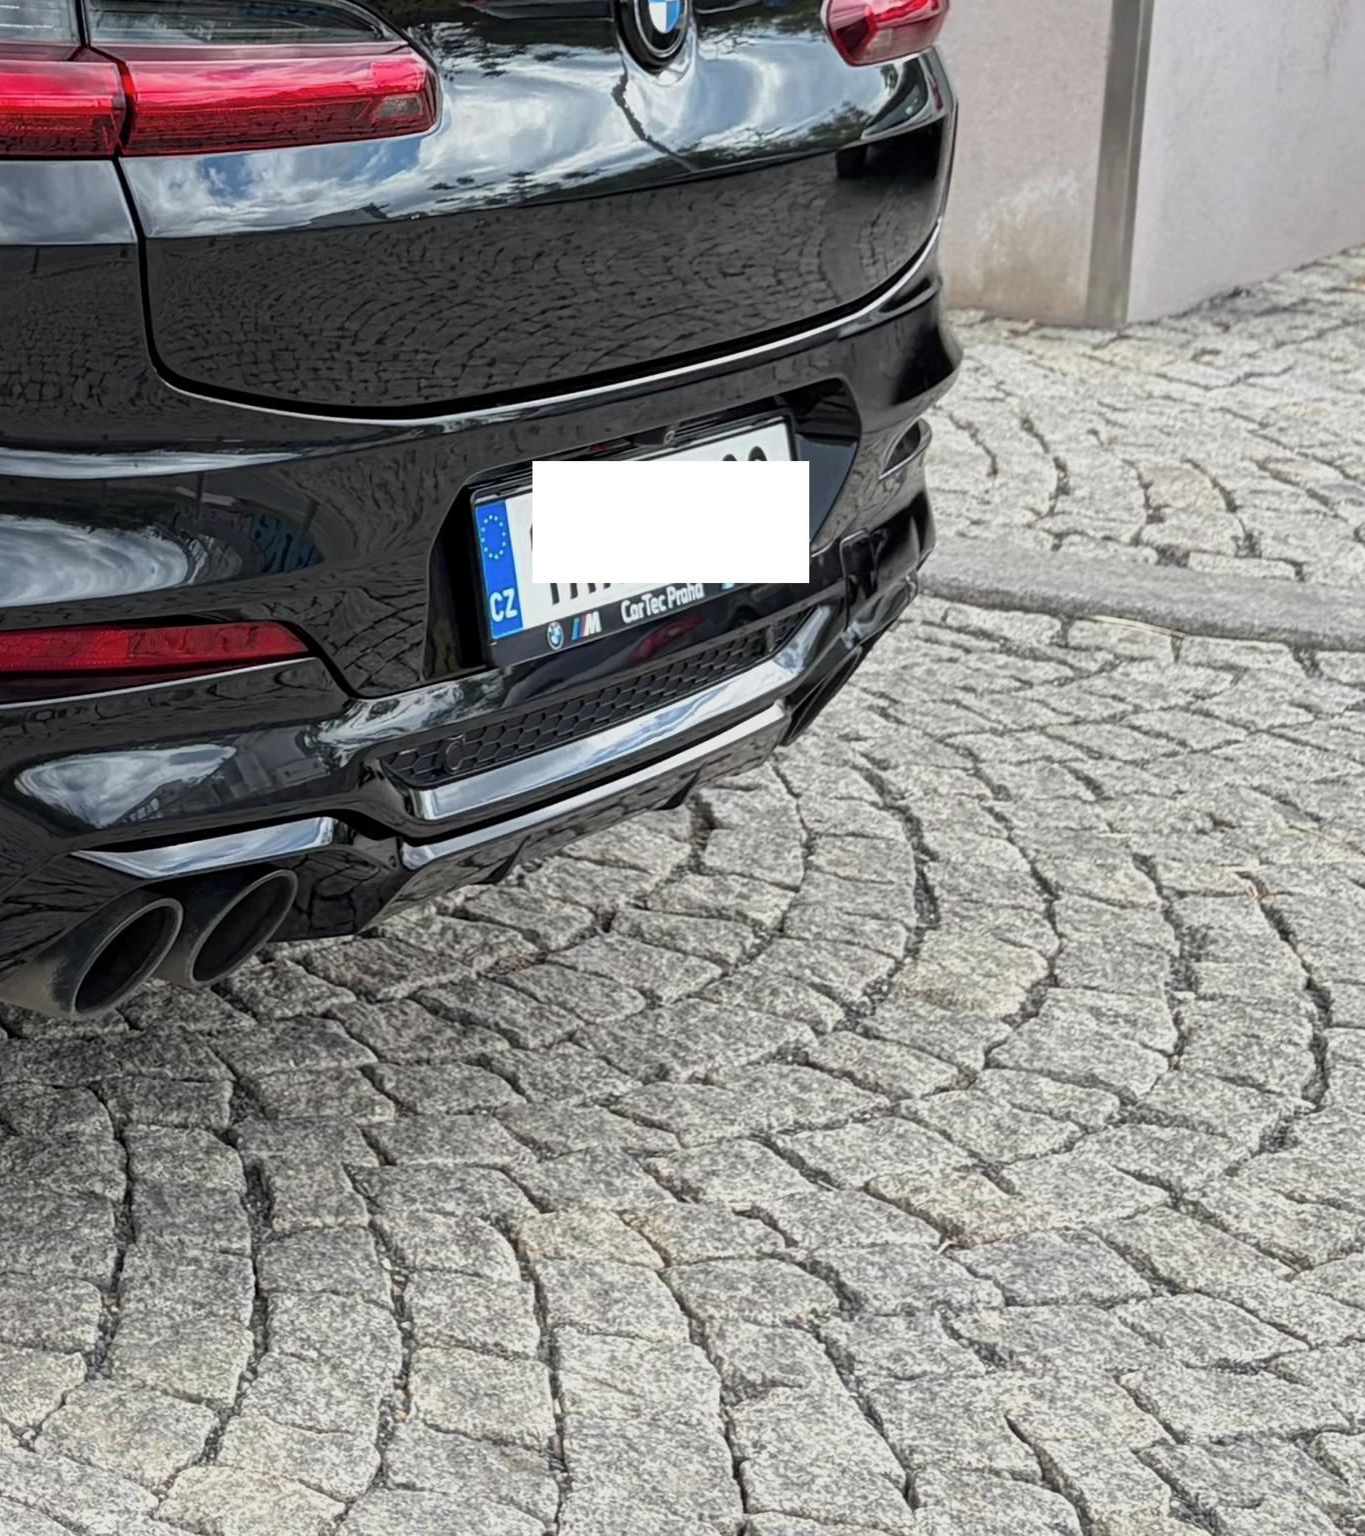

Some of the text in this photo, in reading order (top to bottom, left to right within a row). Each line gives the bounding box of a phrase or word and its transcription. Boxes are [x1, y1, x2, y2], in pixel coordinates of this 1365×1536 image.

[489, 587, 518, 622] CZ
[621, 593, 667, 624] CarTec
[666, 583, 704, 609] Praha
